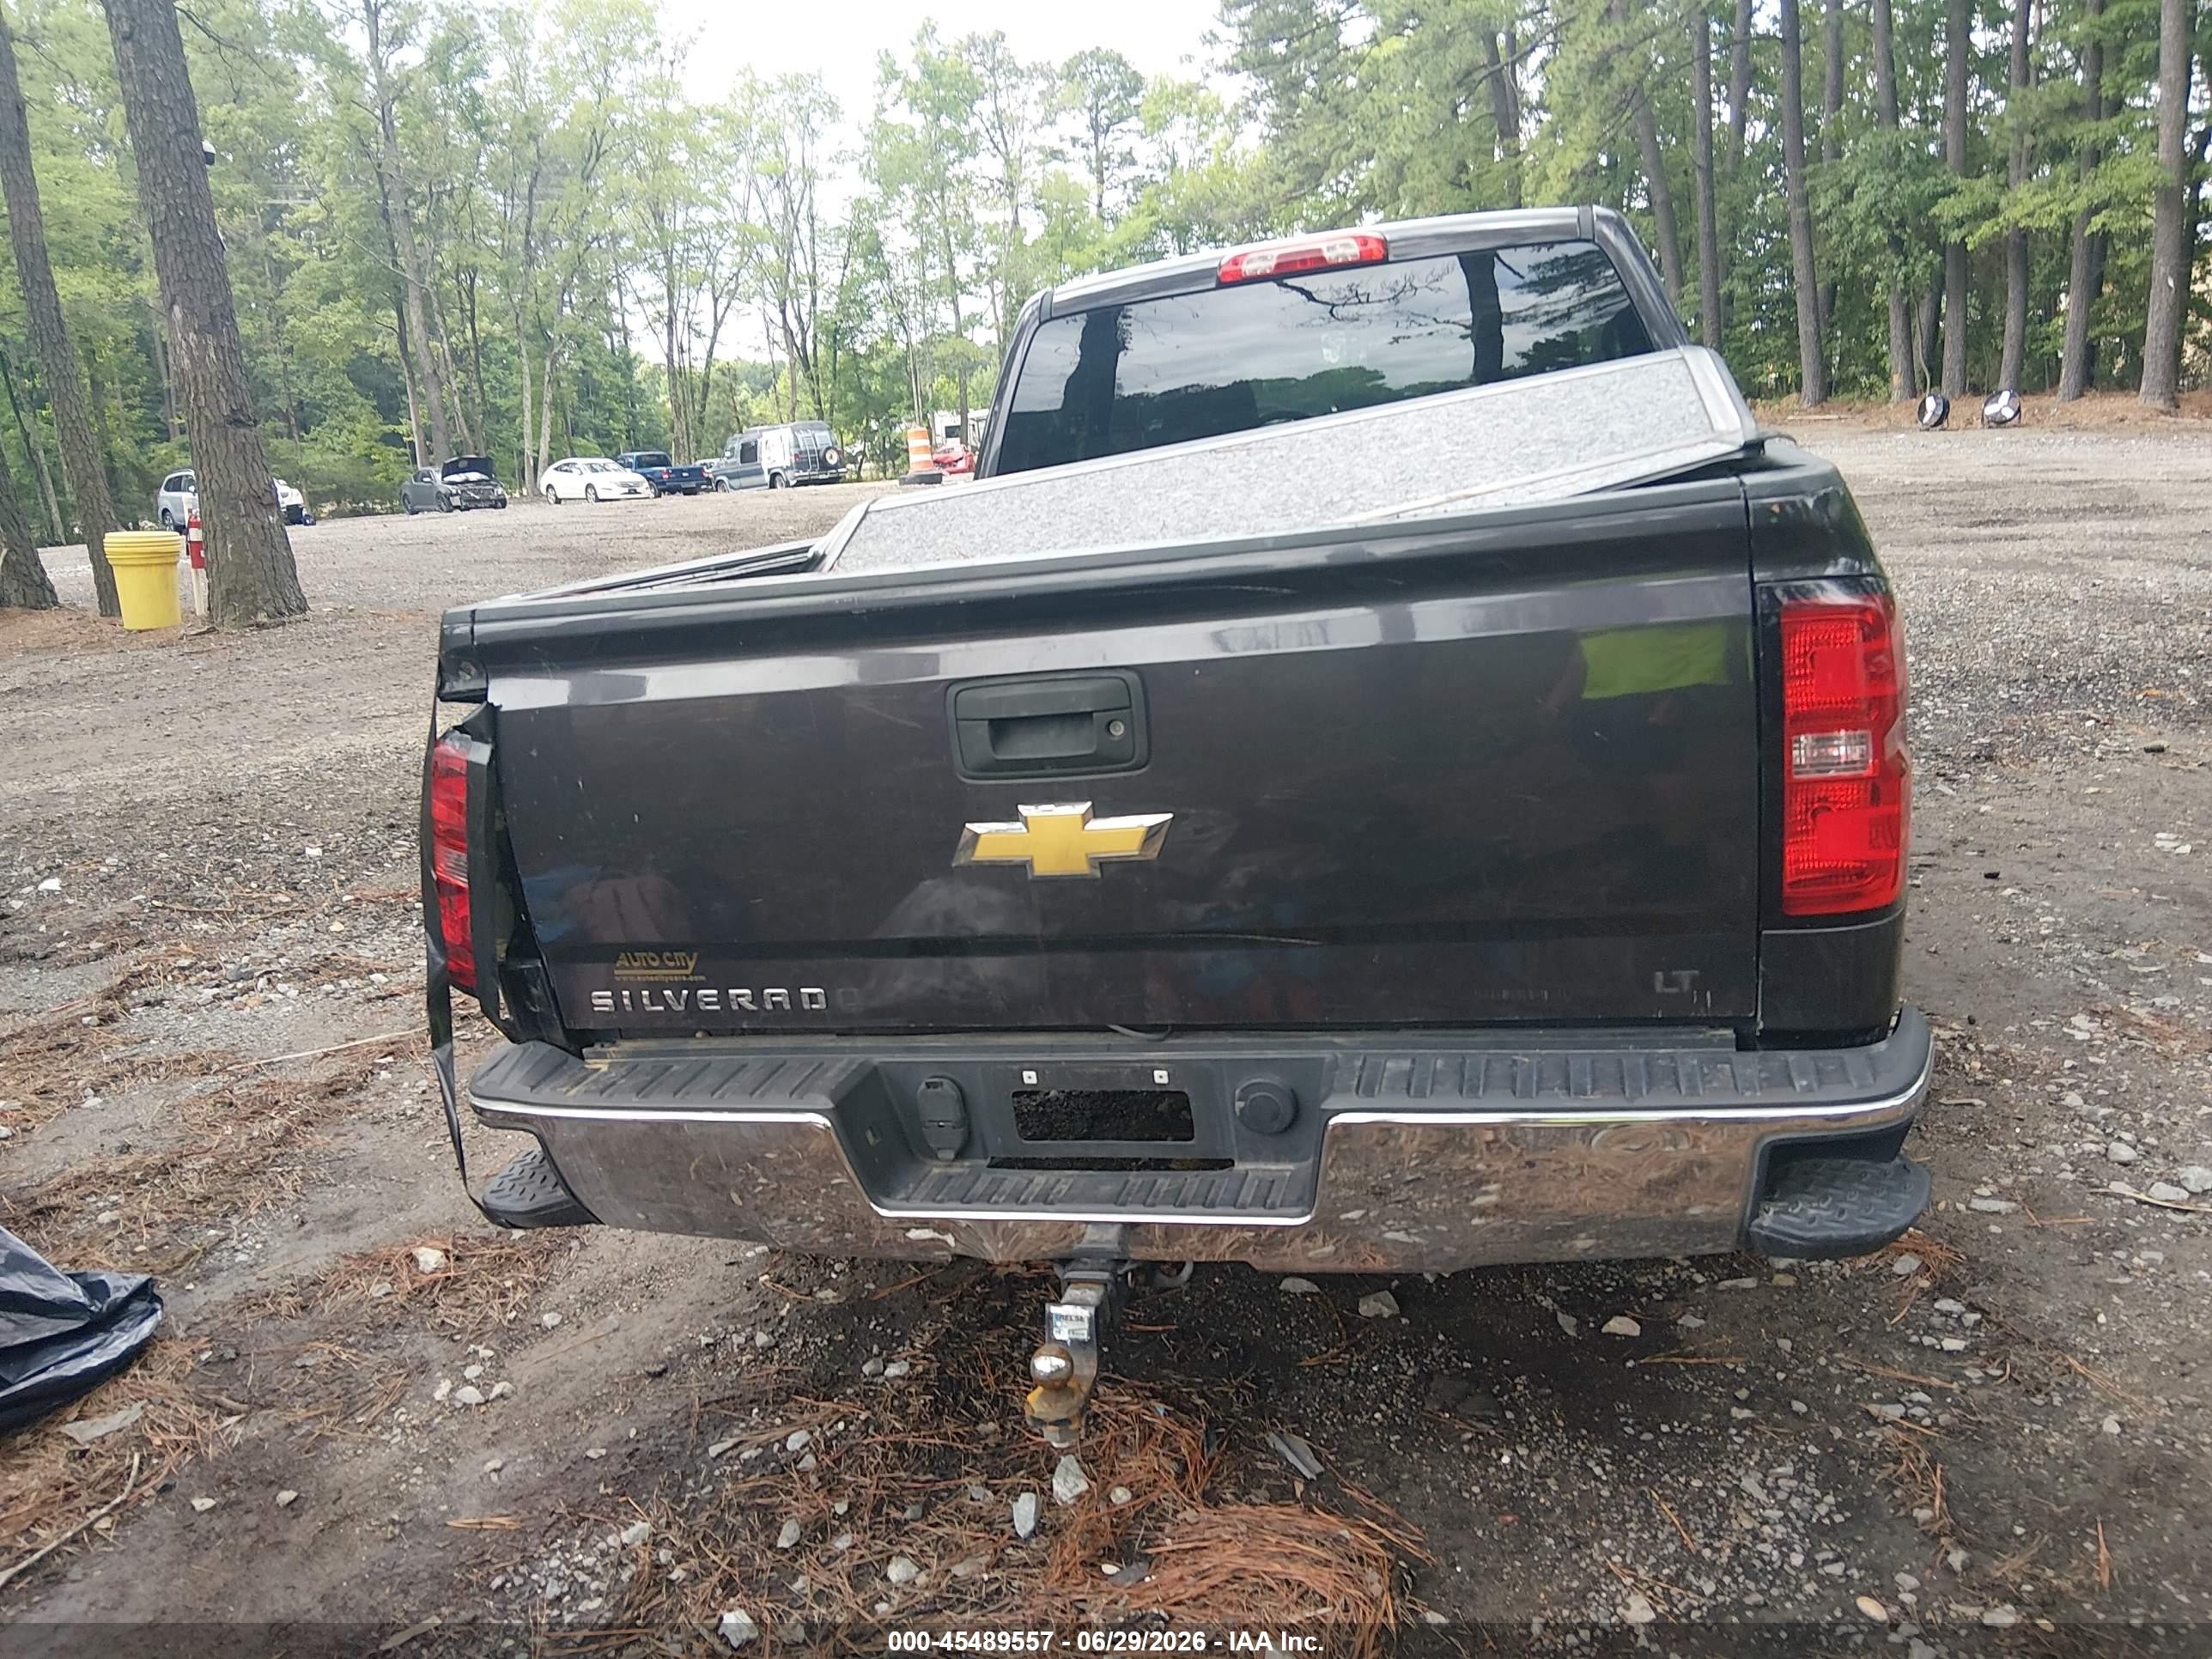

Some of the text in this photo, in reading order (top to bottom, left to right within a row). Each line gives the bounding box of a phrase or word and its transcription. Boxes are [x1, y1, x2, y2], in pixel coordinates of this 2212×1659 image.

[616, 951, 660, 967] AUTO
[1655, 969, 1699, 994] LT
[591, 988, 828, 1012] SILVERAD
